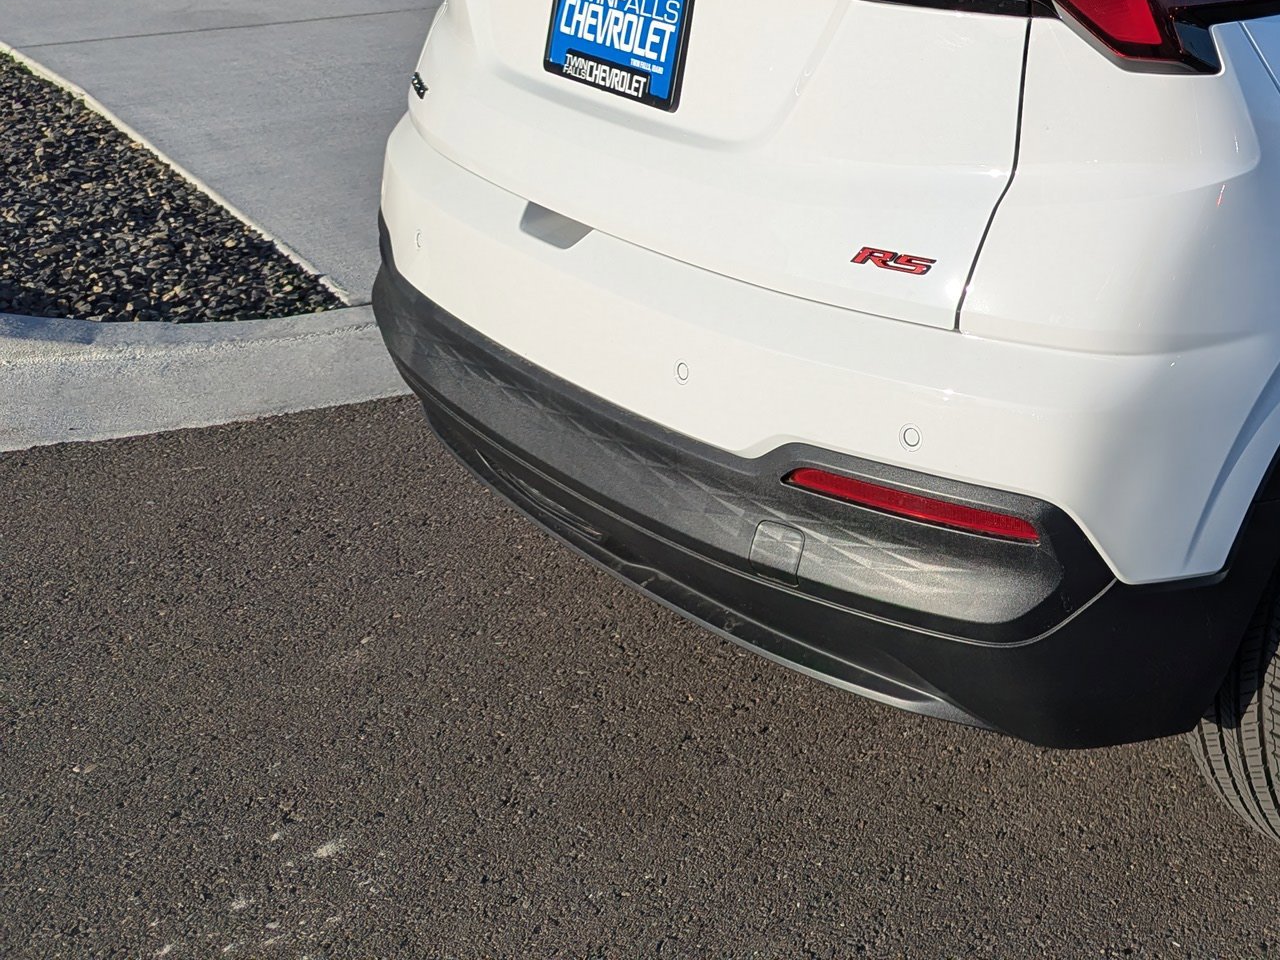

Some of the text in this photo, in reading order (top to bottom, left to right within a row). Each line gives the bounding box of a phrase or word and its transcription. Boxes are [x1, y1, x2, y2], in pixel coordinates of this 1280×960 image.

[563, 64, 587, 79] FALLS
[566, 54, 588, 68] TWIN
[586, 61, 646, 97] CHEVROLET
[850, 247, 937, 275] RS
